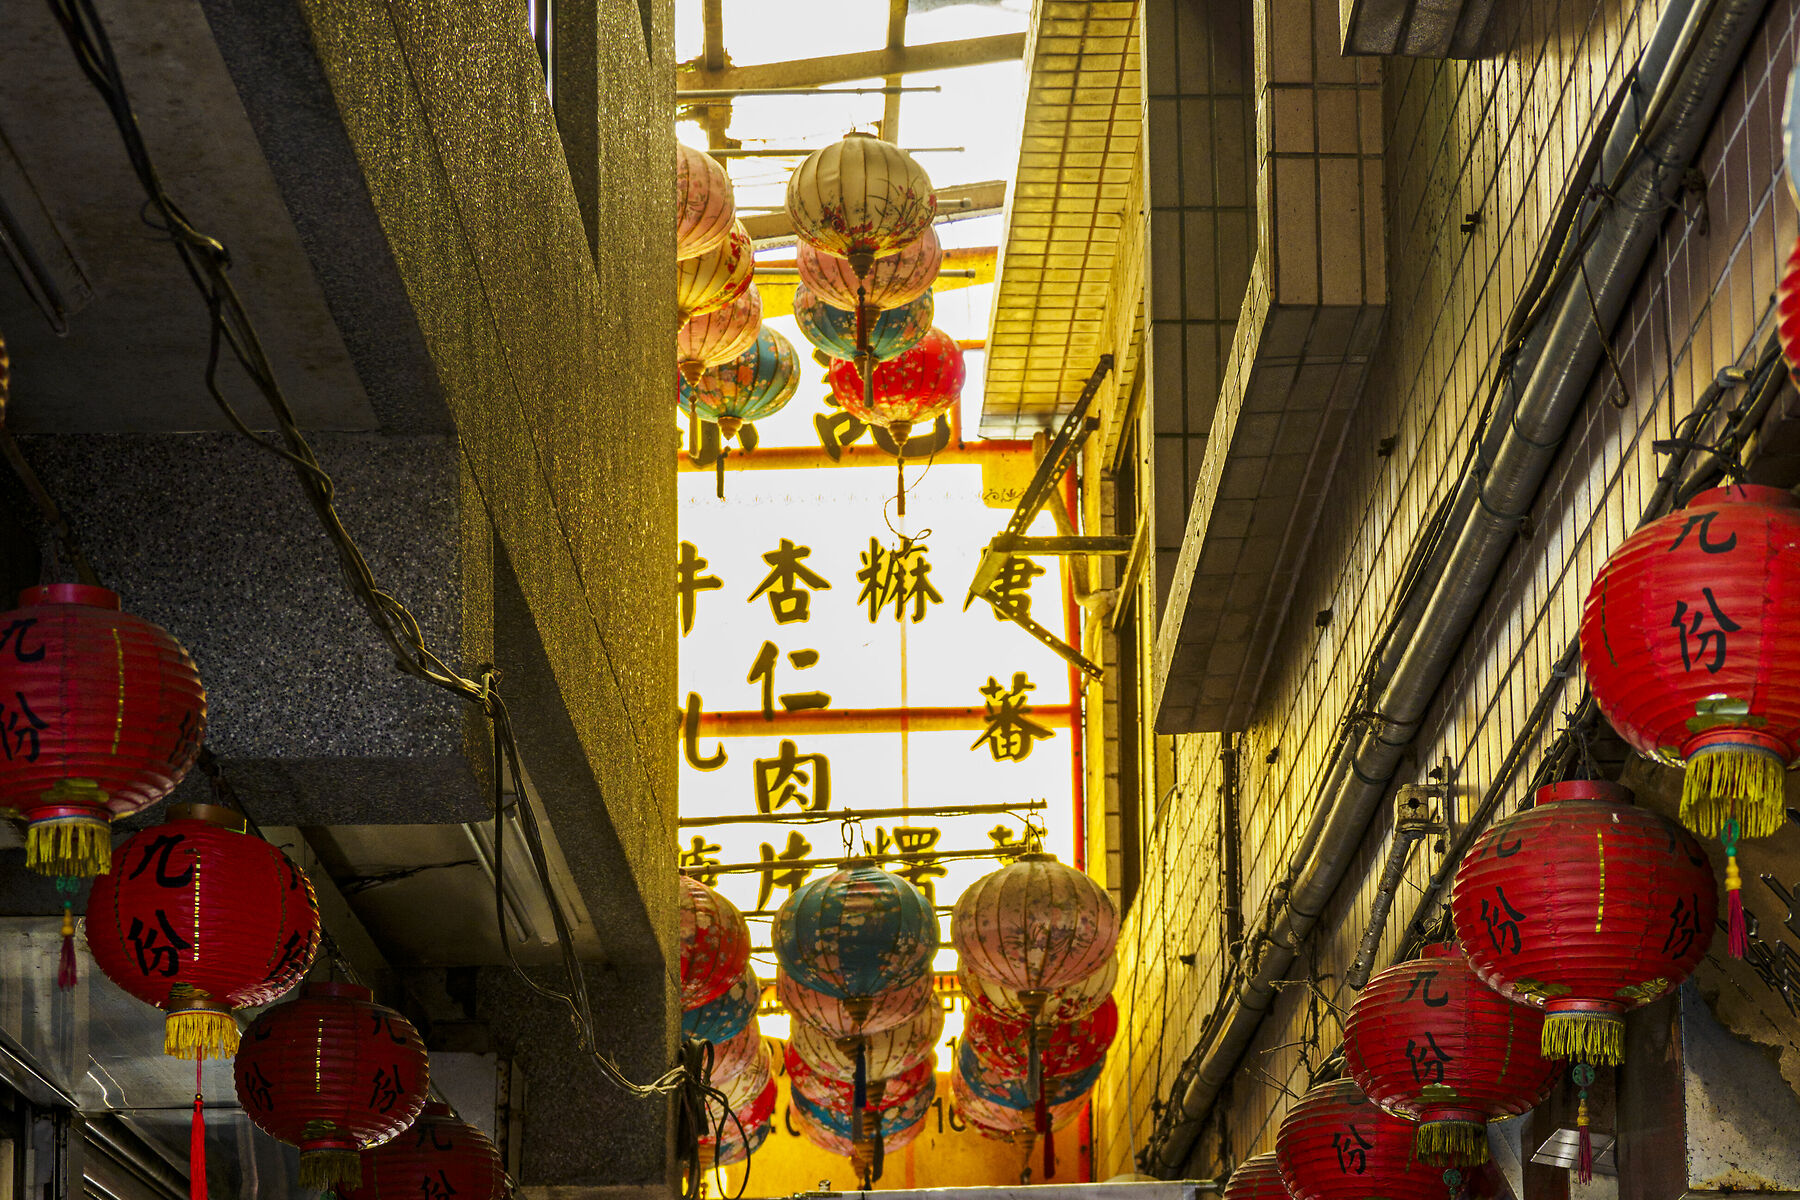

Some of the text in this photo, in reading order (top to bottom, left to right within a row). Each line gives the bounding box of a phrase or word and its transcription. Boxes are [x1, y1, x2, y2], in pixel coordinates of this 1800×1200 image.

[1669, 511, 1741, 674] 九份
[0, 618, 49, 762] 九份
[129, 835, 192, 977] 九份
[1478, 820, 1526, 956] 九份
[1403, 969, 1453, 1086] 九份
